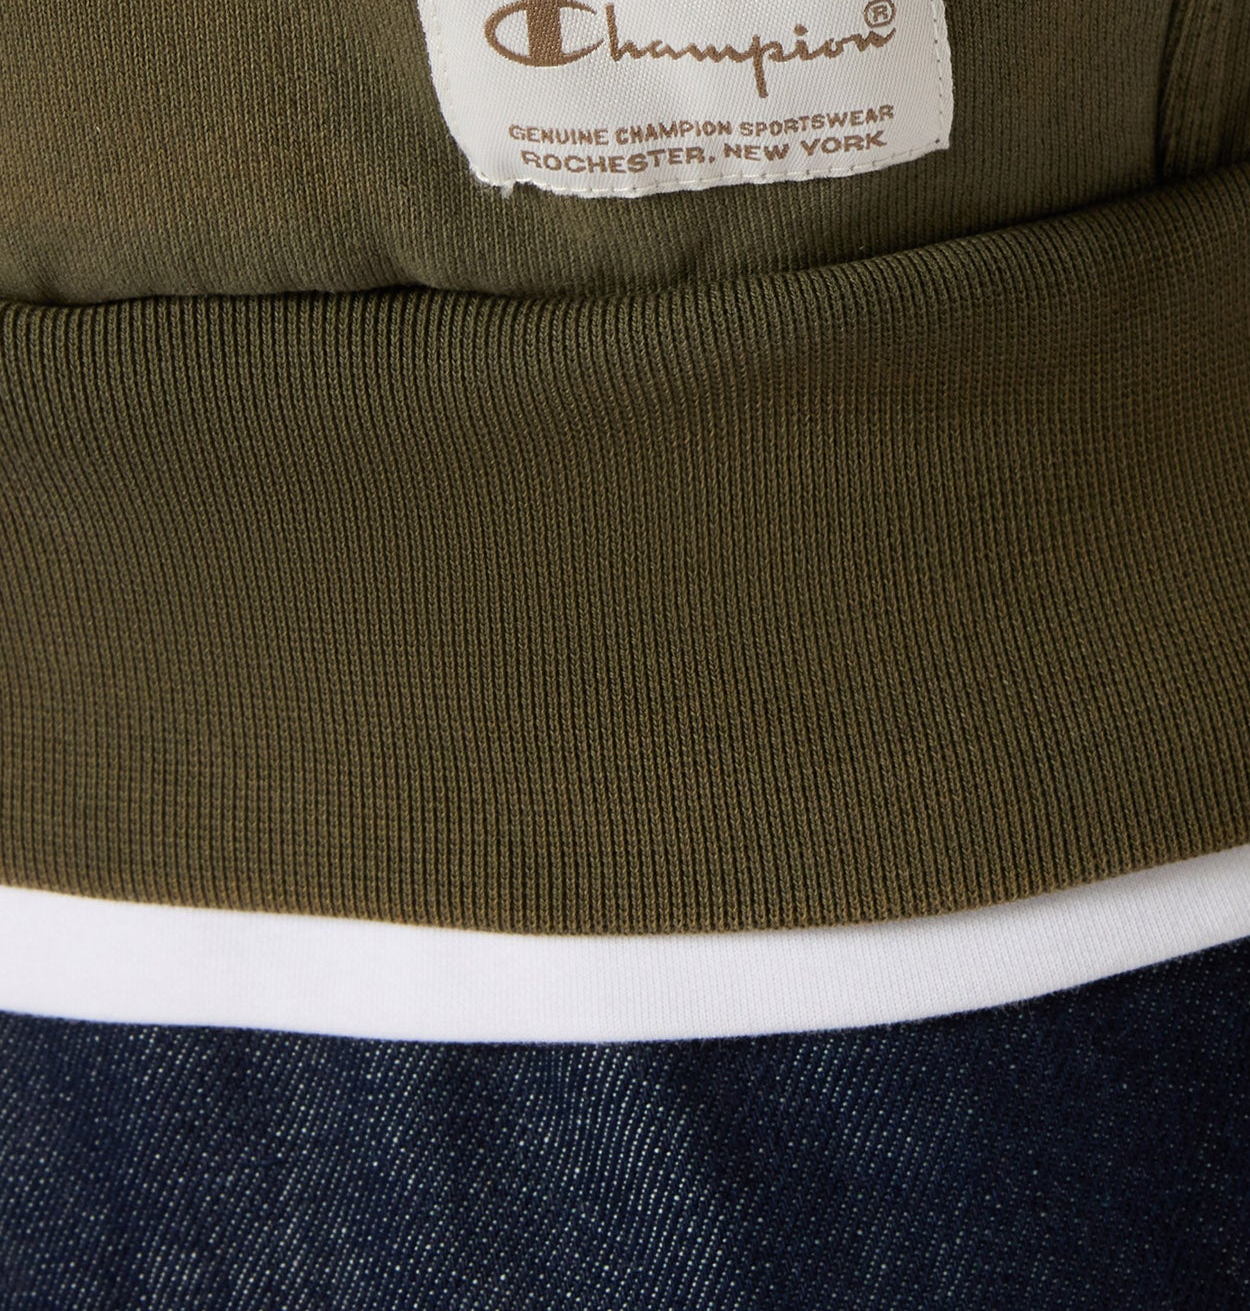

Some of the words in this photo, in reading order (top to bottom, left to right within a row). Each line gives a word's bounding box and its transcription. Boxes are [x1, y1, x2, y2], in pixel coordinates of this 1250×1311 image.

[508, 124, 609, 146] GENUINE
[615, 120, 733, 146] CHAMPION
[740, 104, 895, 137] SPORTSWEAR
[723, 143, 790, 162] NEW
[801, 130, 888, 156] YORK
